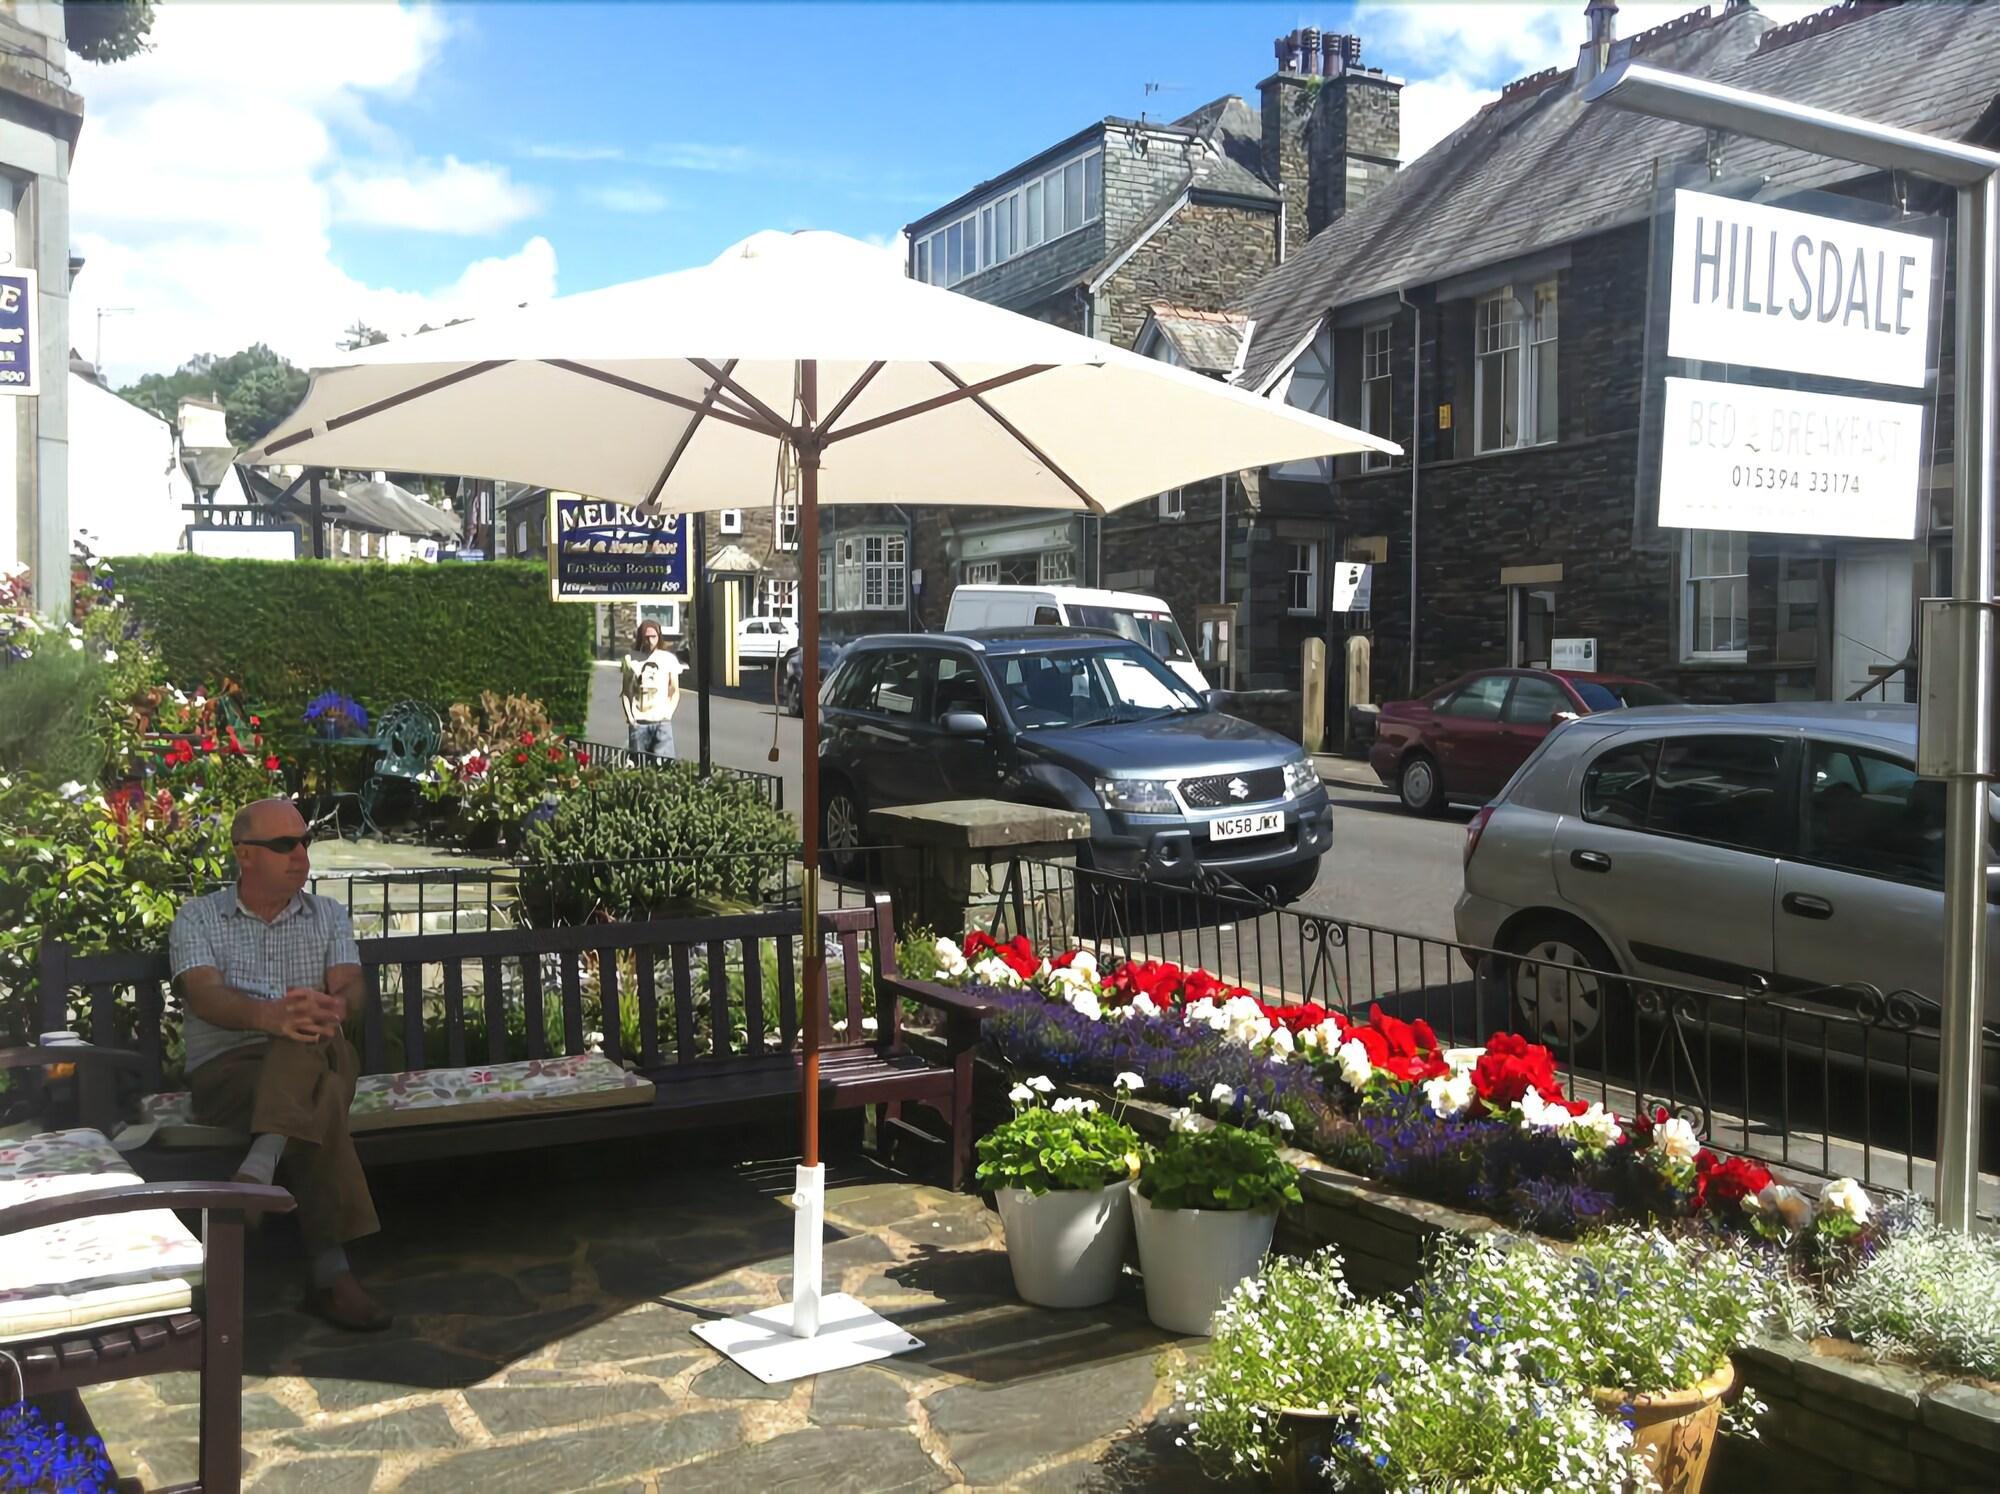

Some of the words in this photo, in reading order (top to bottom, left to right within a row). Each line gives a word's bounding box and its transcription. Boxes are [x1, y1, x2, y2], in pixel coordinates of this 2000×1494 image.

[1692, 216, 1916, 336] HILLSDALE
[1688, 400, 1737, 449] BED
[1769, 408, 1902, 463] BREAKFAST
[1731, 464, 1800, 490] 015394
[1808, 471, 1860, 493] 33174
[561, 503, 680, 535] MELROSE
[1216, 818, 1252, 836] NG58
